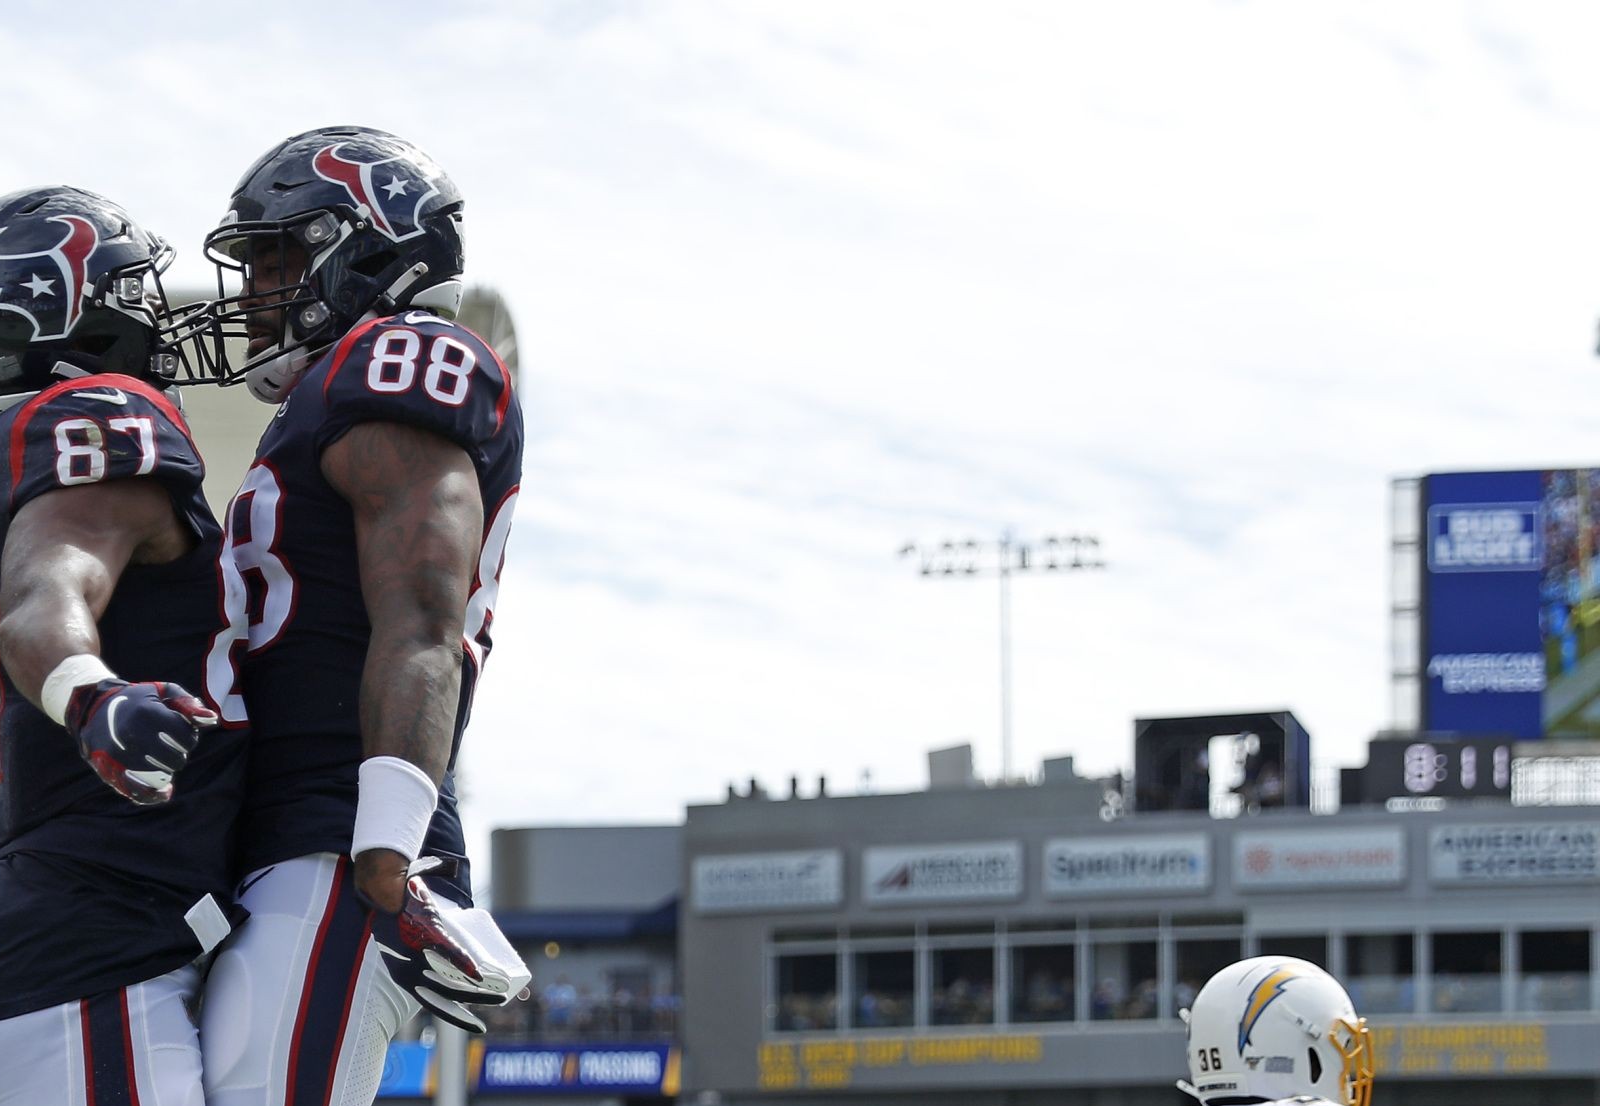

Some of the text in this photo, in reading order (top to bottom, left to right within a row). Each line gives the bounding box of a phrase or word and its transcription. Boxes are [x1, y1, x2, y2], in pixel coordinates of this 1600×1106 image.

[365, 327, 478, 408] 88
[53, 416, 160, 487] 87
[1052, 847, 1190, 882] Spectrum
[910, 1035, 1043, 1063] CHAMPIONS
[1199, 1047, 1222, 1071] 36
